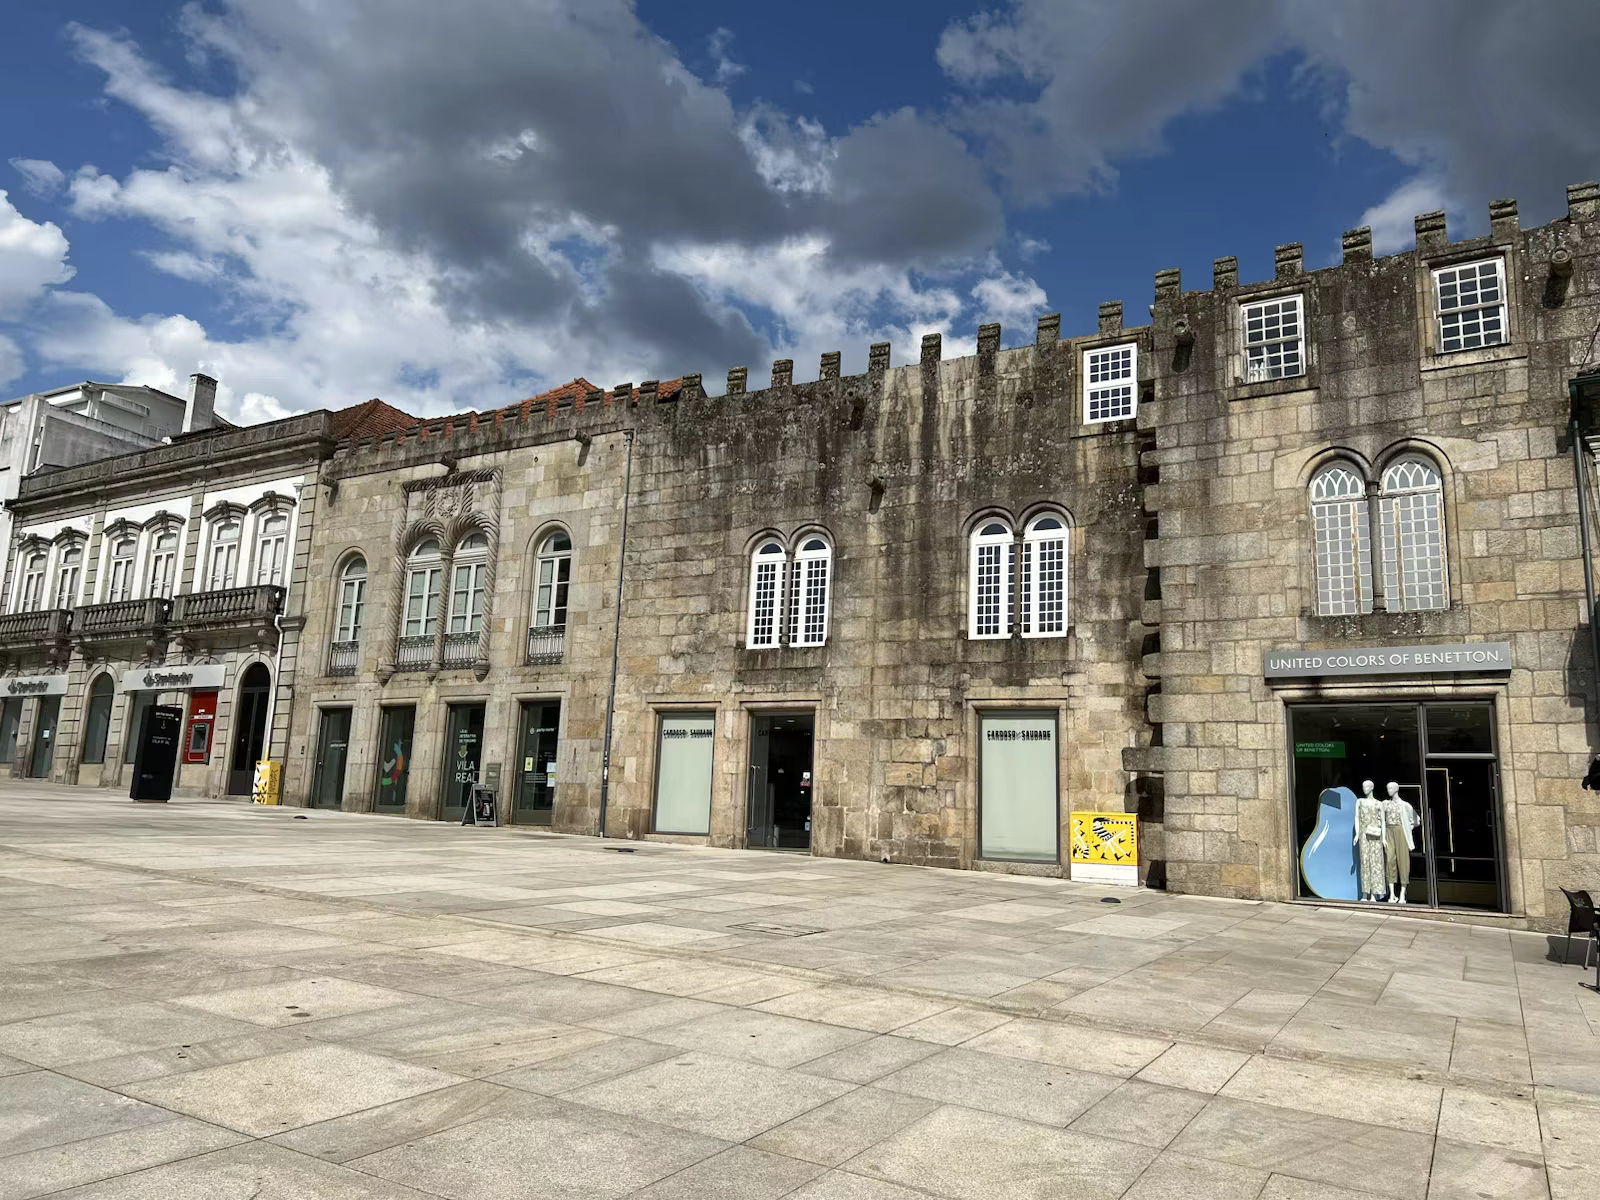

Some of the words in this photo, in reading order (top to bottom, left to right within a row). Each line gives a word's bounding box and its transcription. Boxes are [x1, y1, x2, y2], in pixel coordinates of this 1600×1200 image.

[1270, 656, 1323, 670] UNITED
[1326, 654, 1385, 668] COLORS
[1389, 653, 1410, 666] OF
[1414, 650, 1503, 665] BENETTON.
[456, 760, 475, 771] VILA
[455, 772, 477, 783] REAL
